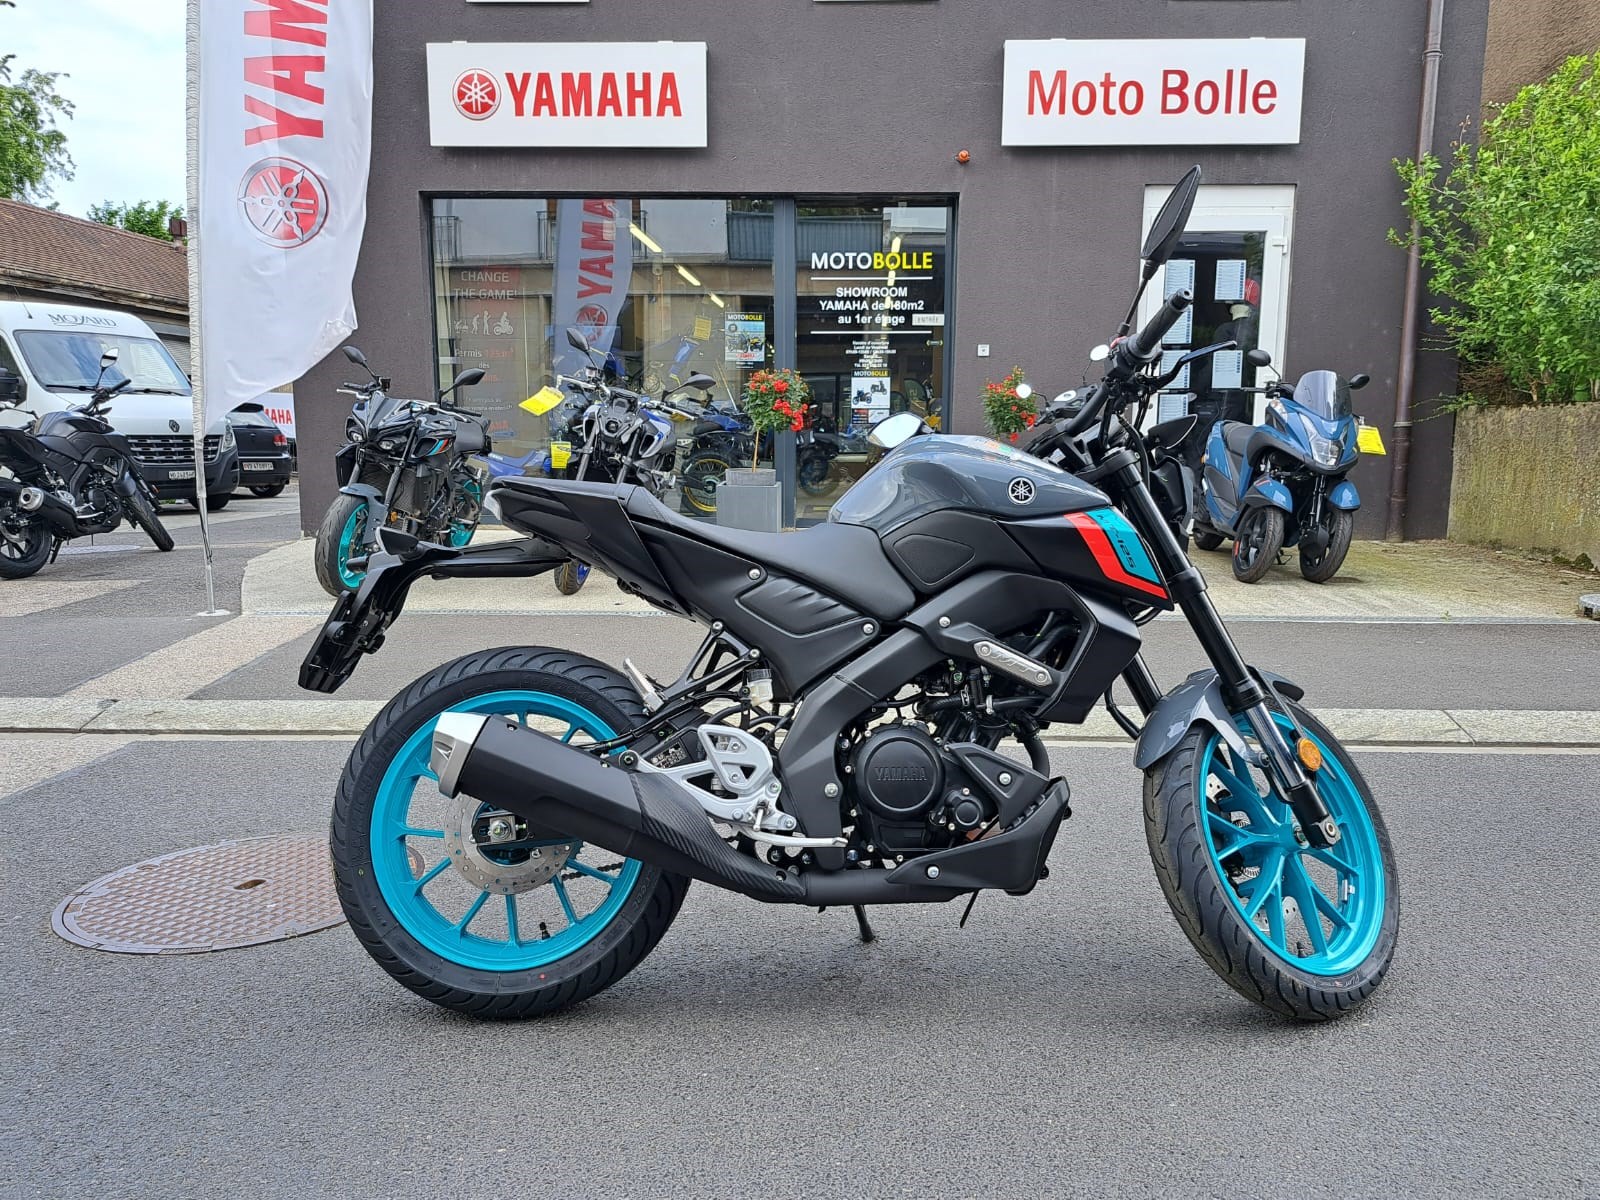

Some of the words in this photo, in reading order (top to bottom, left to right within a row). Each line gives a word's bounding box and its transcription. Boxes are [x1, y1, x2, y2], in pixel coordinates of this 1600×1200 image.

[504, 72, 682, 117] YAMAHA
[1027, 70, 1144, 116] Moto
[1160, 69, 1278, 114] Bolle
[811, 252, 933, 270] MOTOBOLLE
[461, 271, 510, 283] CHANGE
[454, 287, 476, 299] THE
[836, 287, 908, 298] SHOWROOM
[819, 300, 869, 311] YAMAHA
[871, 300, 886, 311] de
[47, 313, 118, 328] MOYARD
[837, 315, 852, 324] au
[854, 314, 872, 324] 1er
[875, 313, 905, 326] étage
[874, 766, 928, 781] YAMAHA
